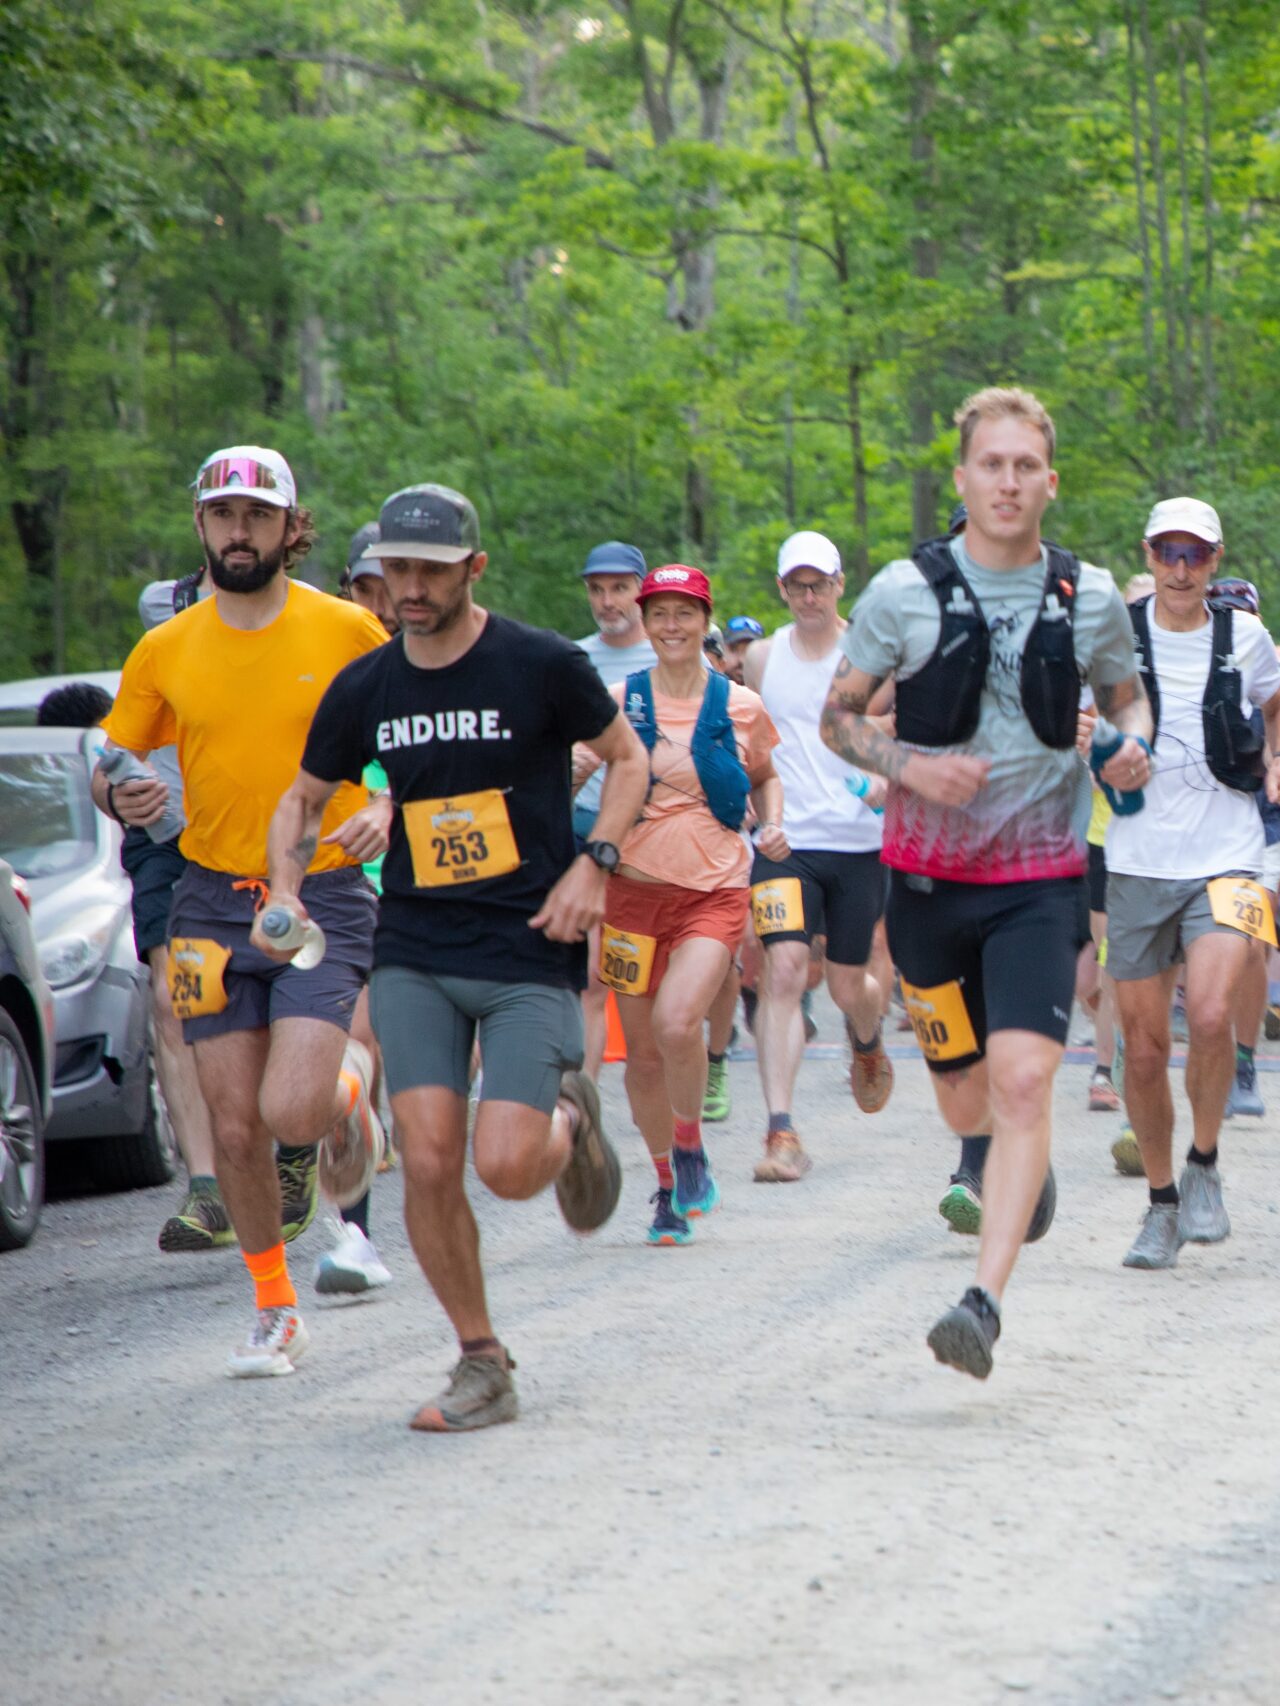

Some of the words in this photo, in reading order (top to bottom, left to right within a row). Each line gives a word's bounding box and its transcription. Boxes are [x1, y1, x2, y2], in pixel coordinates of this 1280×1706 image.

[376, 710, 512, 752] ENDURE.
[431, 830, 489, 869] 253
[1233, 899, 1265, 929] 237
[603, 952, 640, 984] 200
[172, 972, 203, 1002] 254
[912, 1017, 949, 1045] 60
